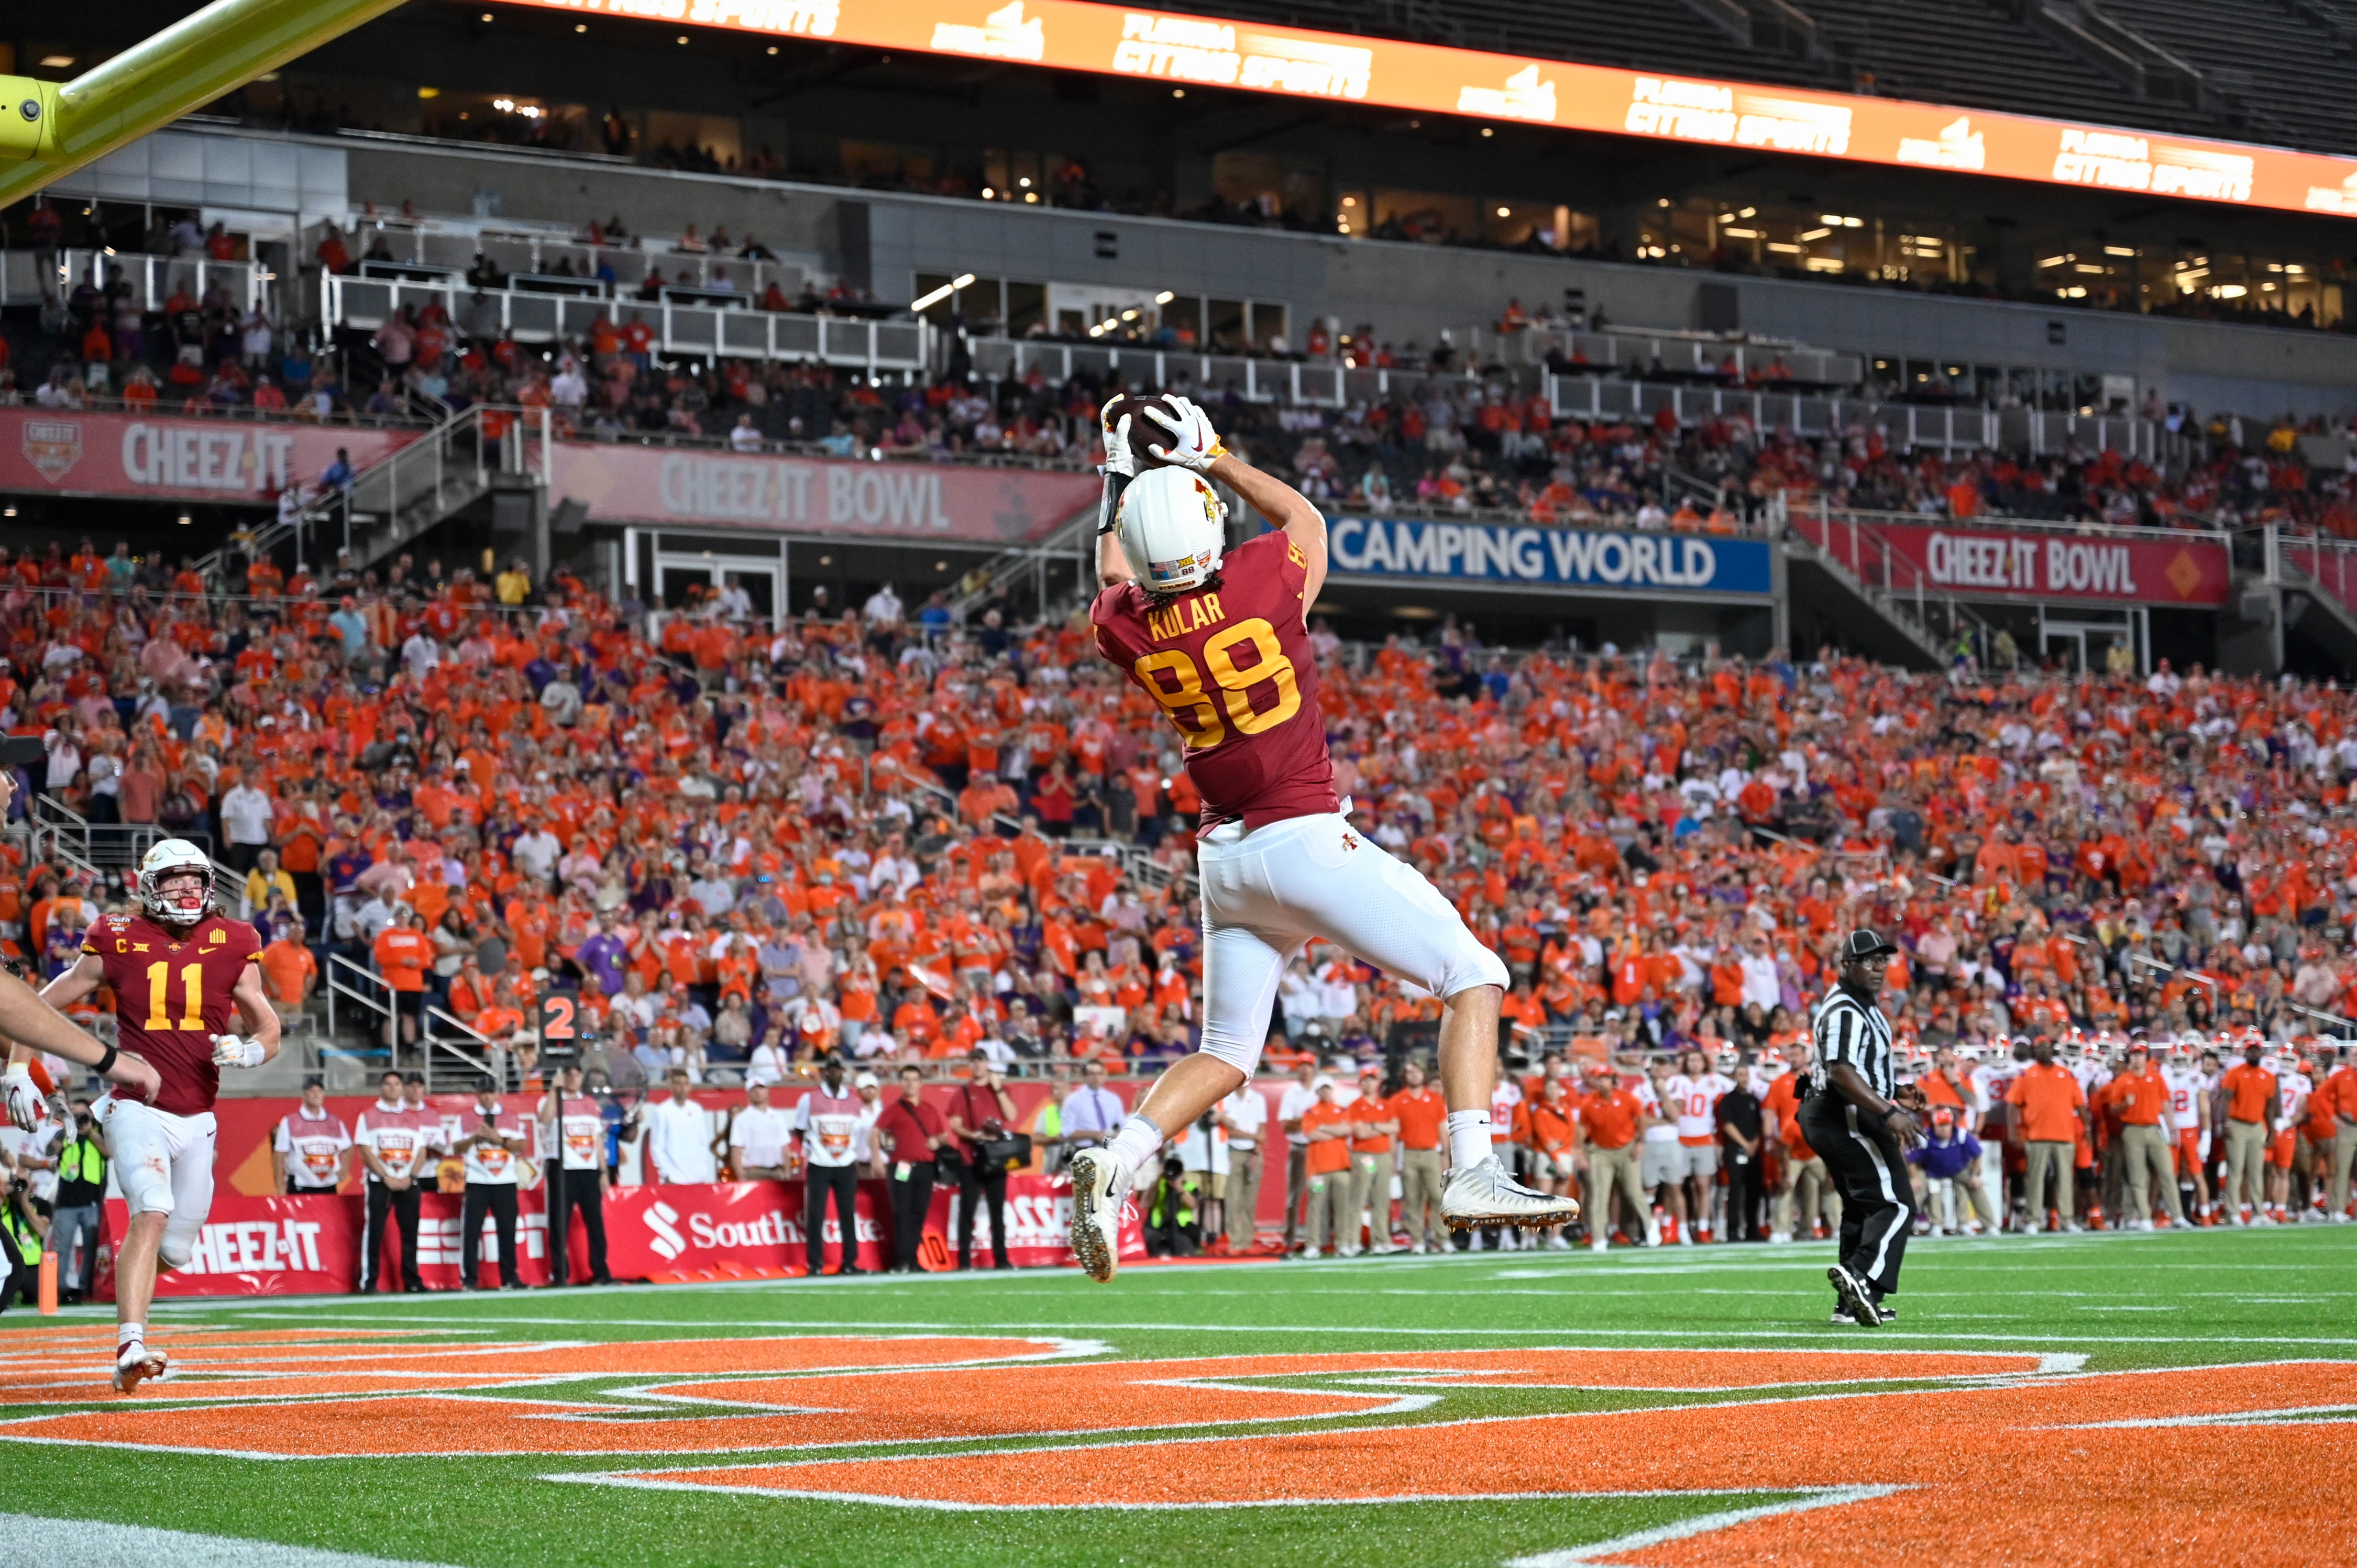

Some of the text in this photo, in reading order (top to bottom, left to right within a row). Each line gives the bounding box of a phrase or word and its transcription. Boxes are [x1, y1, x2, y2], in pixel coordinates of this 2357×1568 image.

[1239, 55, 1371, 98] SPORTS
[828, 465, 948, 528] BOWL
[1182, 566, 1194, 575] 88
[1331, 518, 1716, 587] CAMPING WORLD
[2046, 540, 2136, 594] BOWL
[1148, 593, 1226, 641] KOLAR
[1135, 617, 1301, 748] 88
[116, 938, 127, 953] C
[145, 961, 204, 1030] 11
[544, 997, 575, 1039] 2
[2174, 1090, 2188, 1112] 2
[176, 1219, 321, 1275] HEEZ-IT
